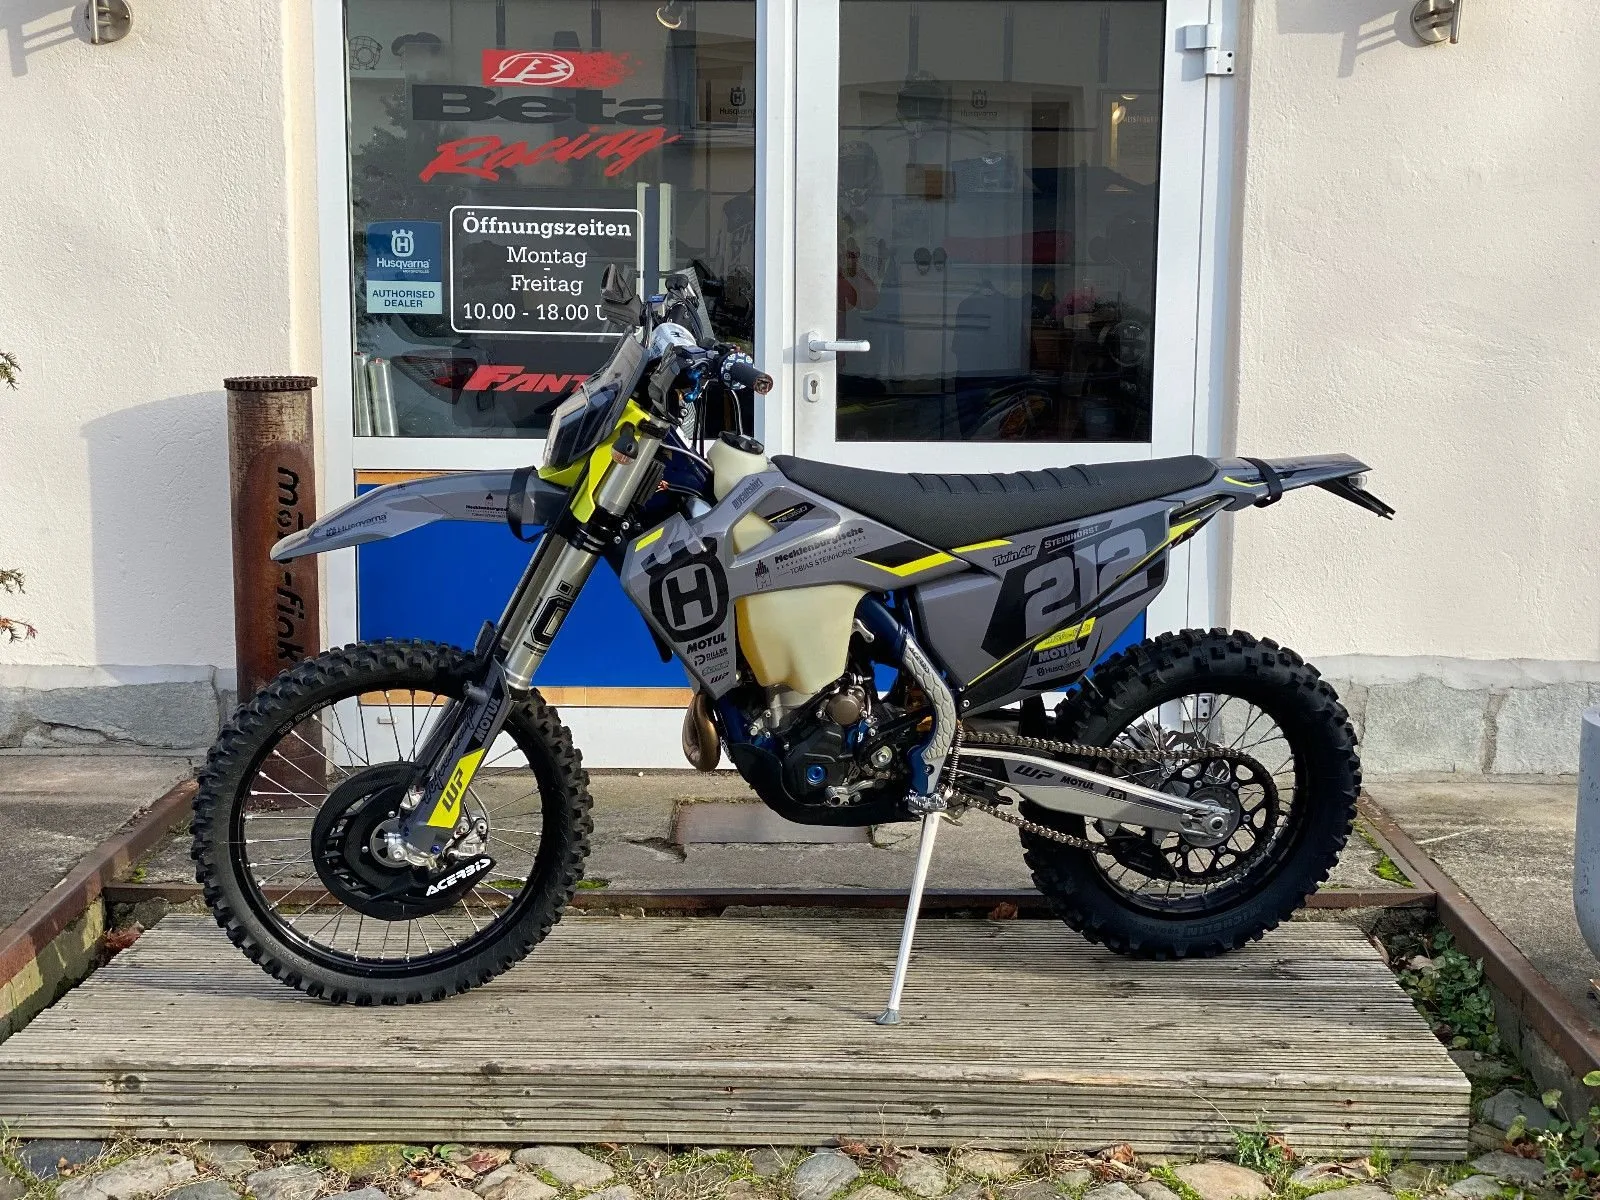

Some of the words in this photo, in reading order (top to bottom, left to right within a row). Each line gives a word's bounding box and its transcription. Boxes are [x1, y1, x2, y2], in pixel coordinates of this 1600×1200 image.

[412, 84, 674, 125] Beta
[419, 126, 682, 183] Racing
[462, 212, 632, 239] Öffnungszeiten
[376, 257, 431, 270] Husqvarna
[506, 246, 588, 268] Montag
[372, 289, 436, 299] AUTHORISED
[511, 274, 584, 296] Freitag
[384, 299, 423, 308] DEALER
[463, 302, 516, 320] 10.00
[536, 303, 589, 321] 18.00
[595, 304, 608, 321] U
[463, 364, 593, 393] FANT
[774, 527, 864, 564] Mecklenburgische
[1044, 525, 1098, 549] STEINHORST
[790, 561, 814, 575] TOBIAS
[814, 546, 857, 566] STEINHORST
[1023, 527, 1150, 640] 212
[686, 632, 727, 655] MOTUL
[1038, 641, 1081, 663] MOTUL
[474, 697, 502, 743] MOTUL
[441, 766, 464, 813] WP
[1013, 764, 1056, 780] WP
[1059, 775, 1095, 791] MOTUL
[425, 856, 492, 897] ACERBIS
